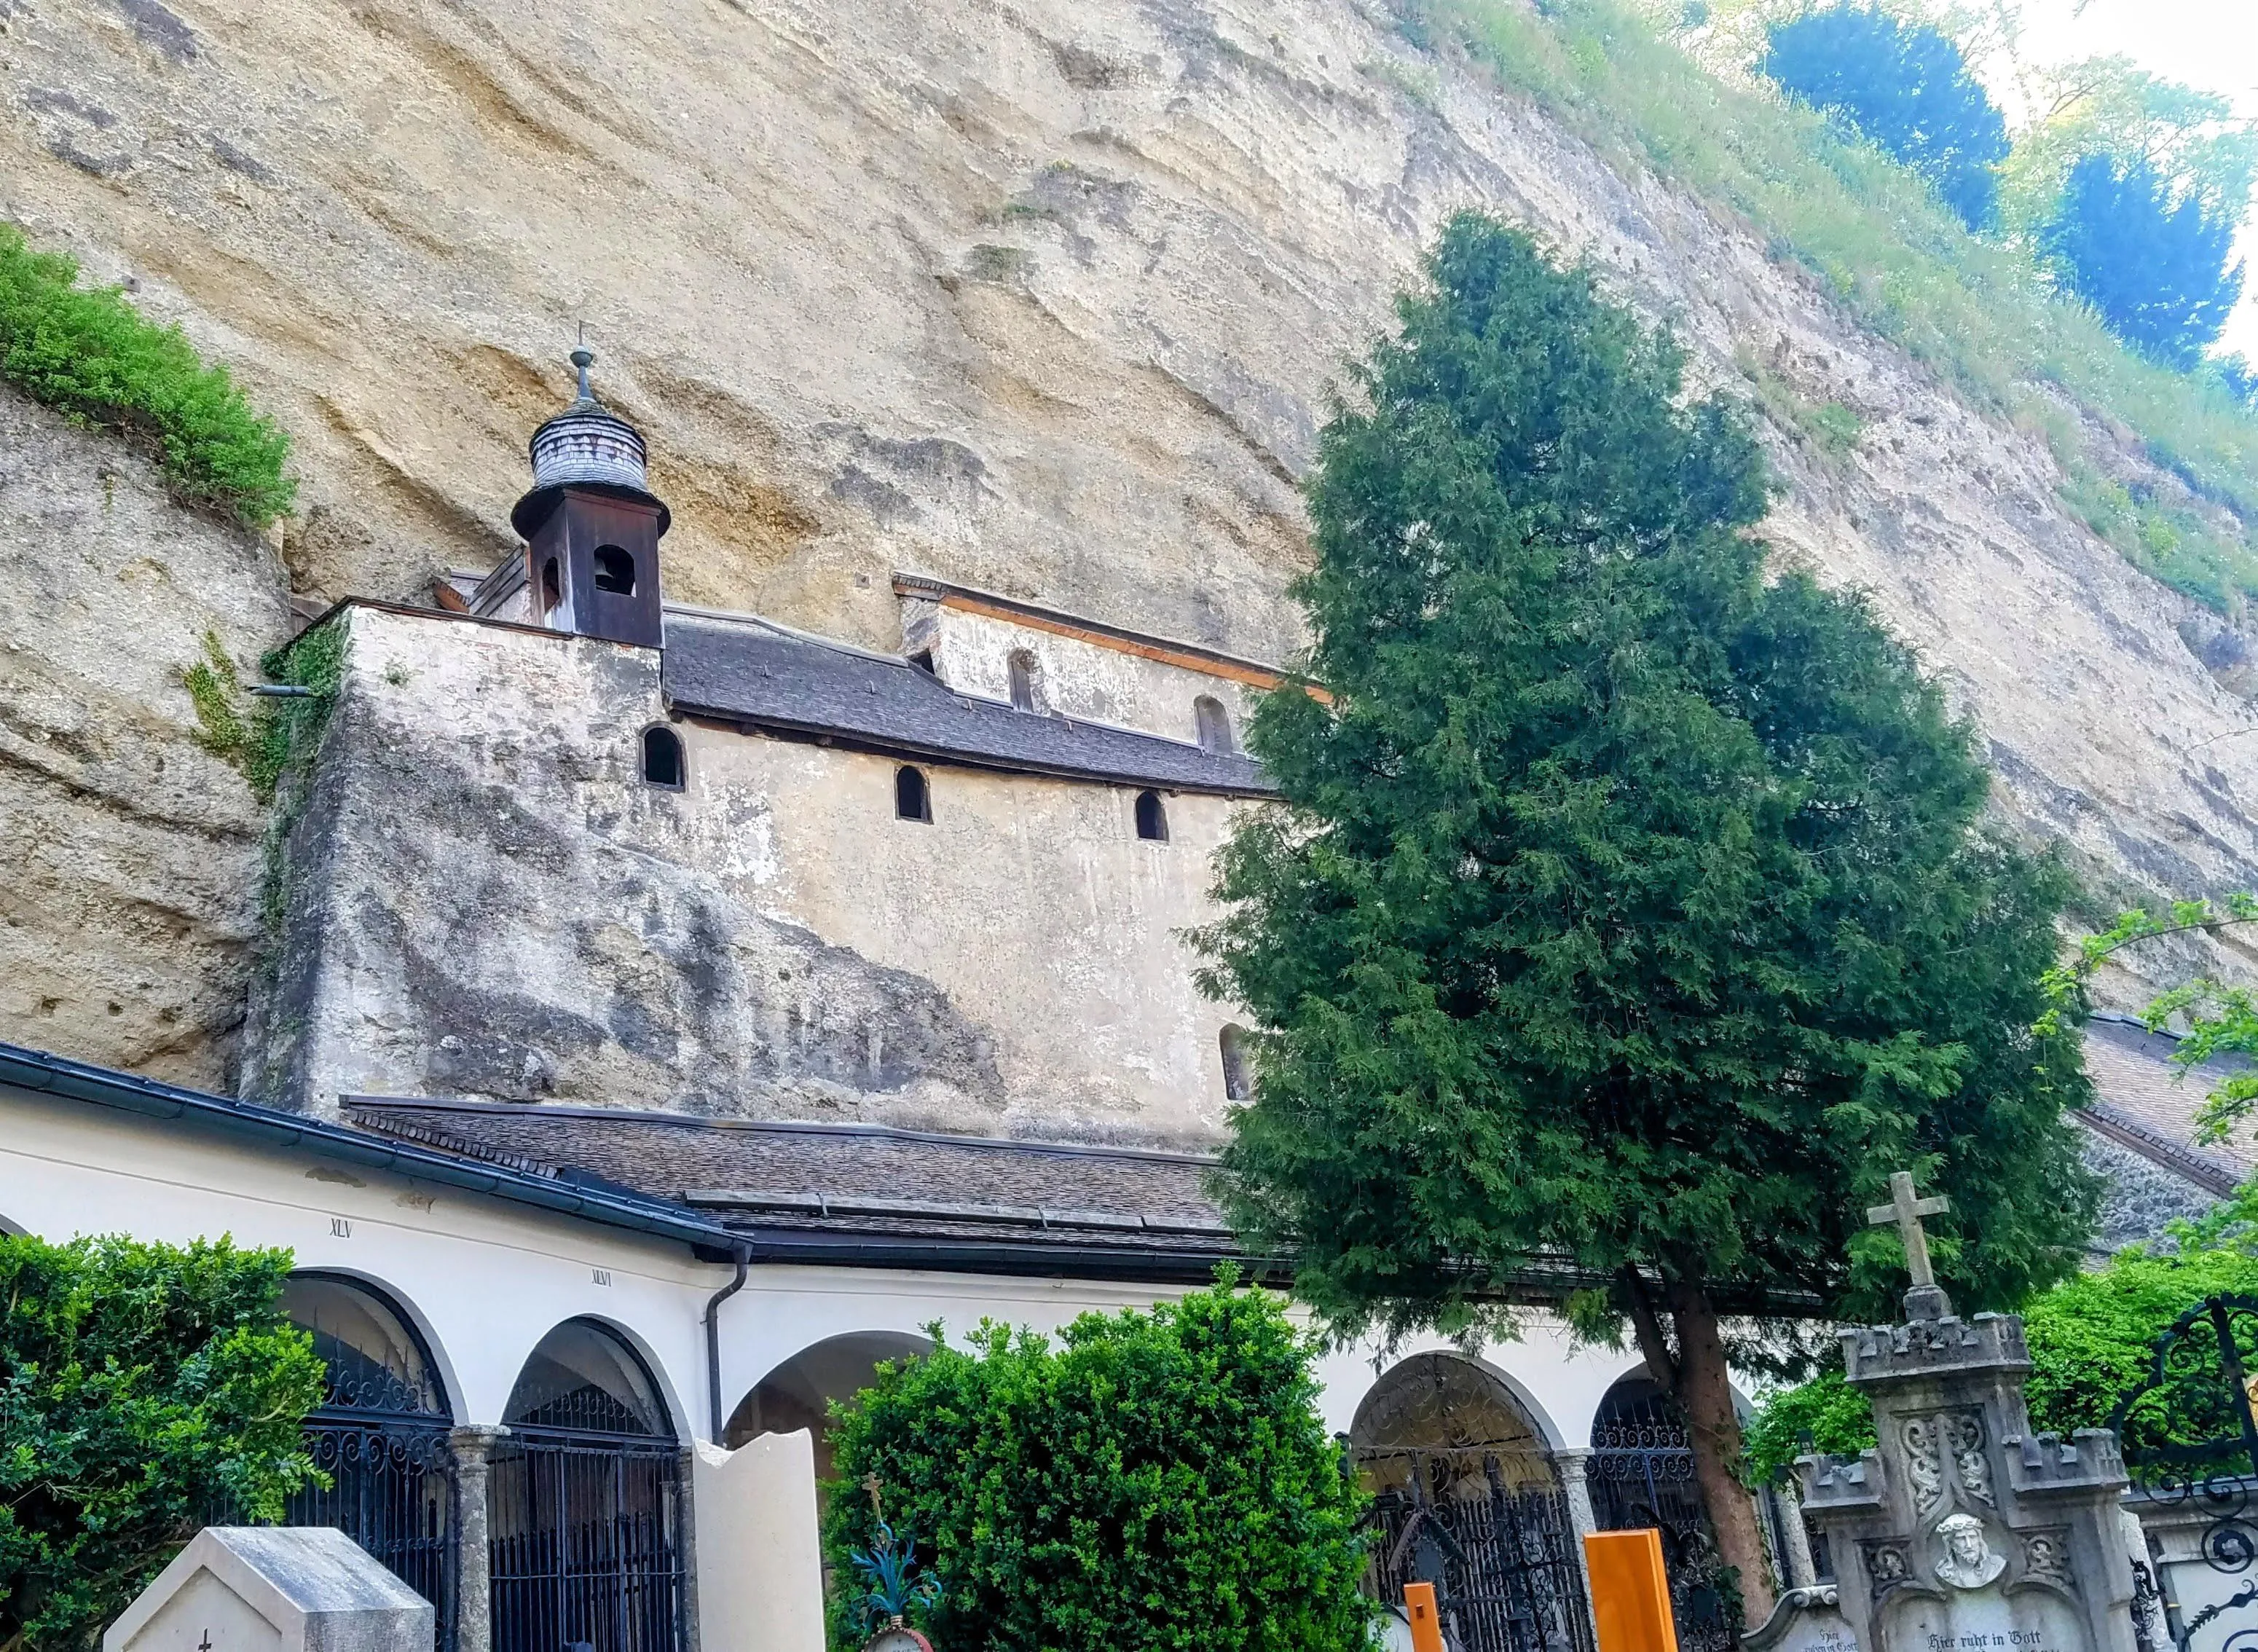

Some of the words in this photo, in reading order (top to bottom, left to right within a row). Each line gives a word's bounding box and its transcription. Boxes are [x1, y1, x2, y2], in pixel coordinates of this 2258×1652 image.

[329, 1218, 353, 1238] XLV
[591, 1269, 611, 1287] XLVI
[1928, 1634, 1956, 1650] Hier
[1961, 1633, 1987, 1649] ruht
[1992, 1633, 2005, 1645] in
[2008, 1630, 2041, 1645] Gott
